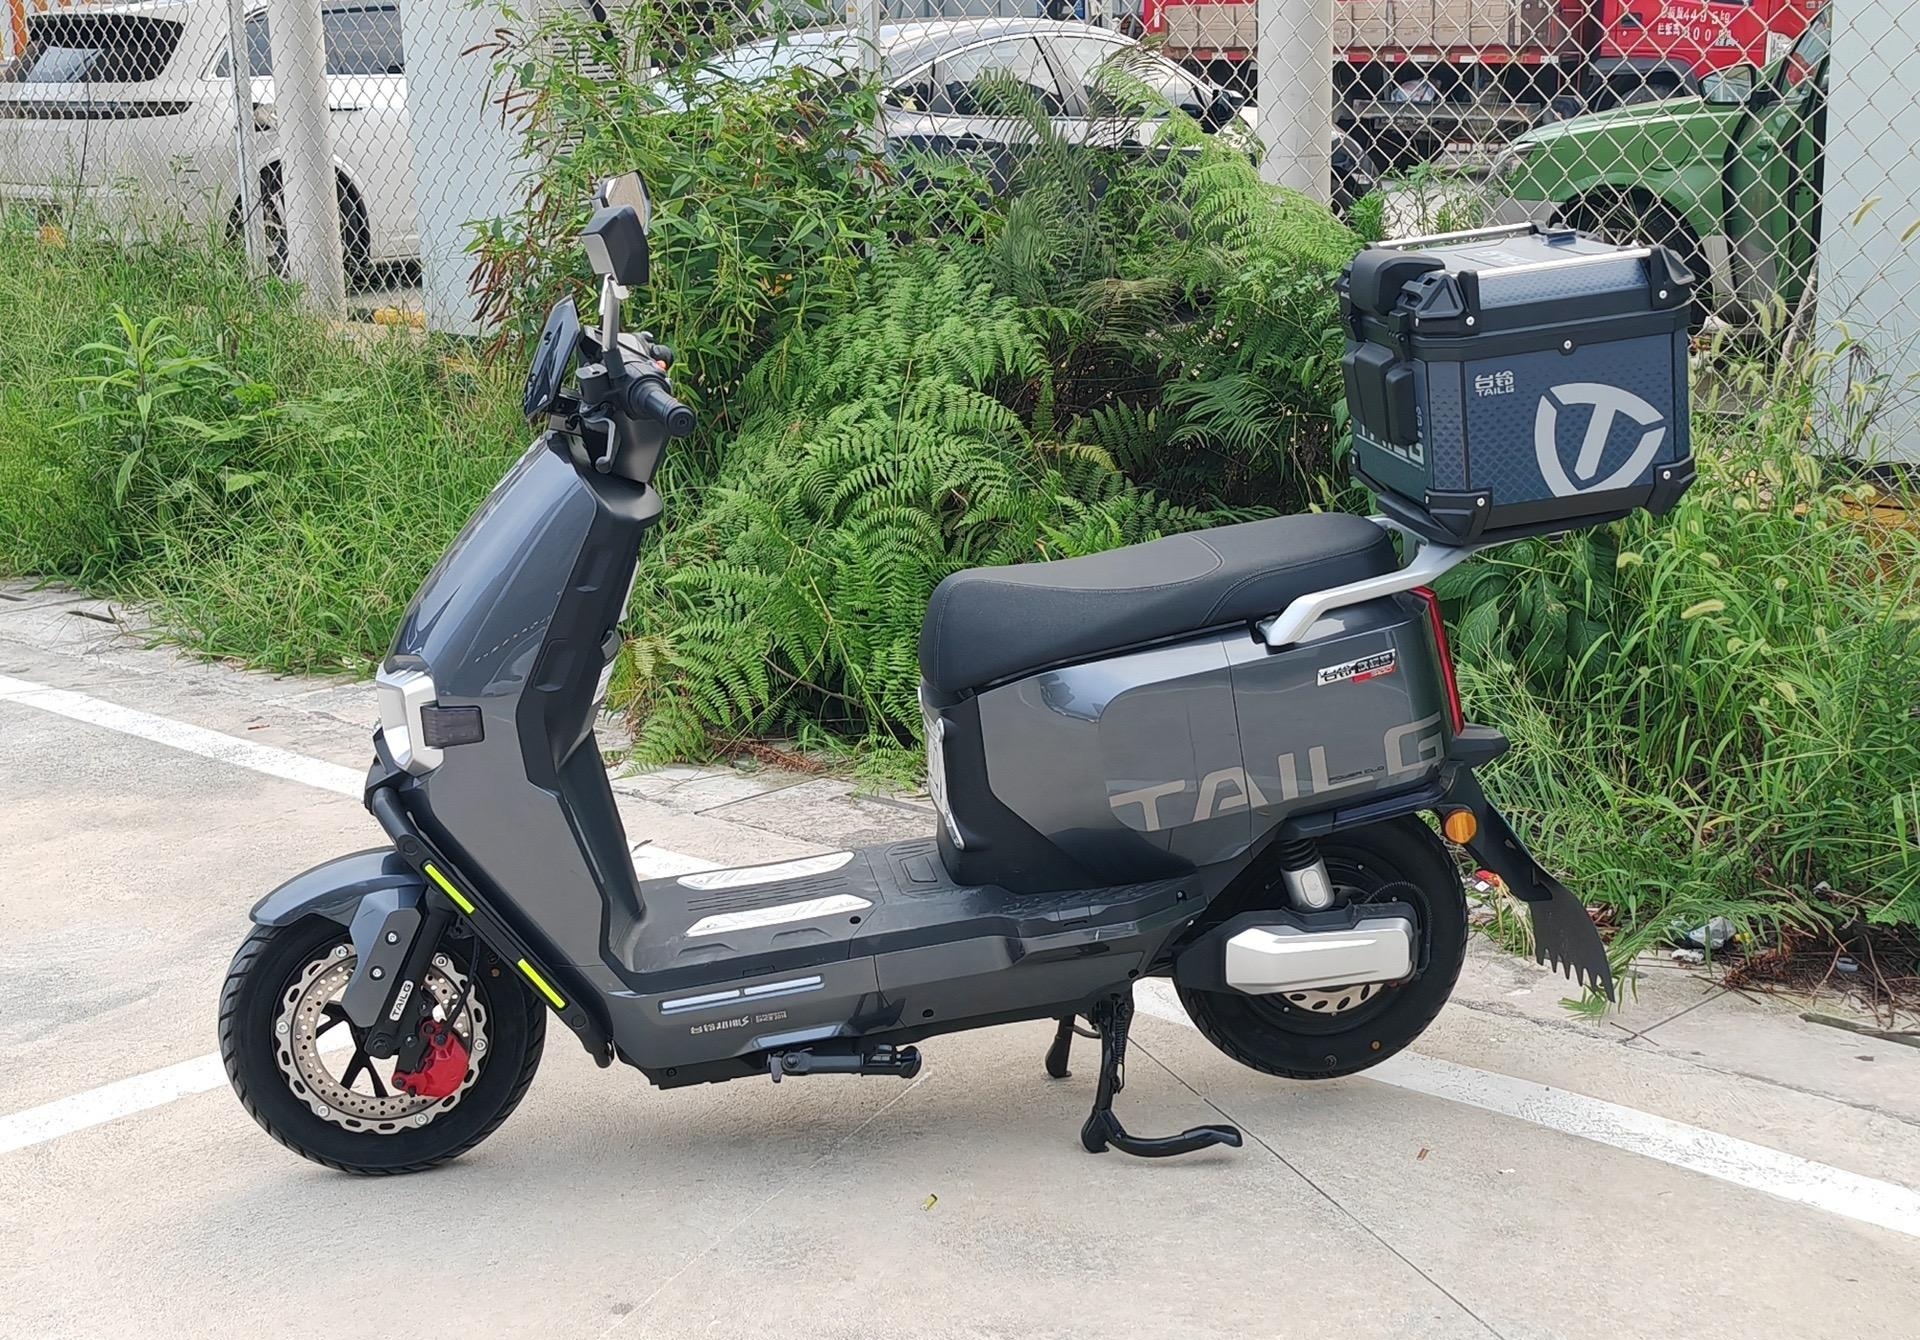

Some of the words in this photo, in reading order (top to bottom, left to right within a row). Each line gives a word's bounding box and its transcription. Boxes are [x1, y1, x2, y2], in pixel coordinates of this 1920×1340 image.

[1475, 370, 1514, 389] 台铃
[1475, 385, 1514, 397] TAILG
[1109, 711, 1446, 831] TAILG
[391, 983, 412, 1017] TAILG
